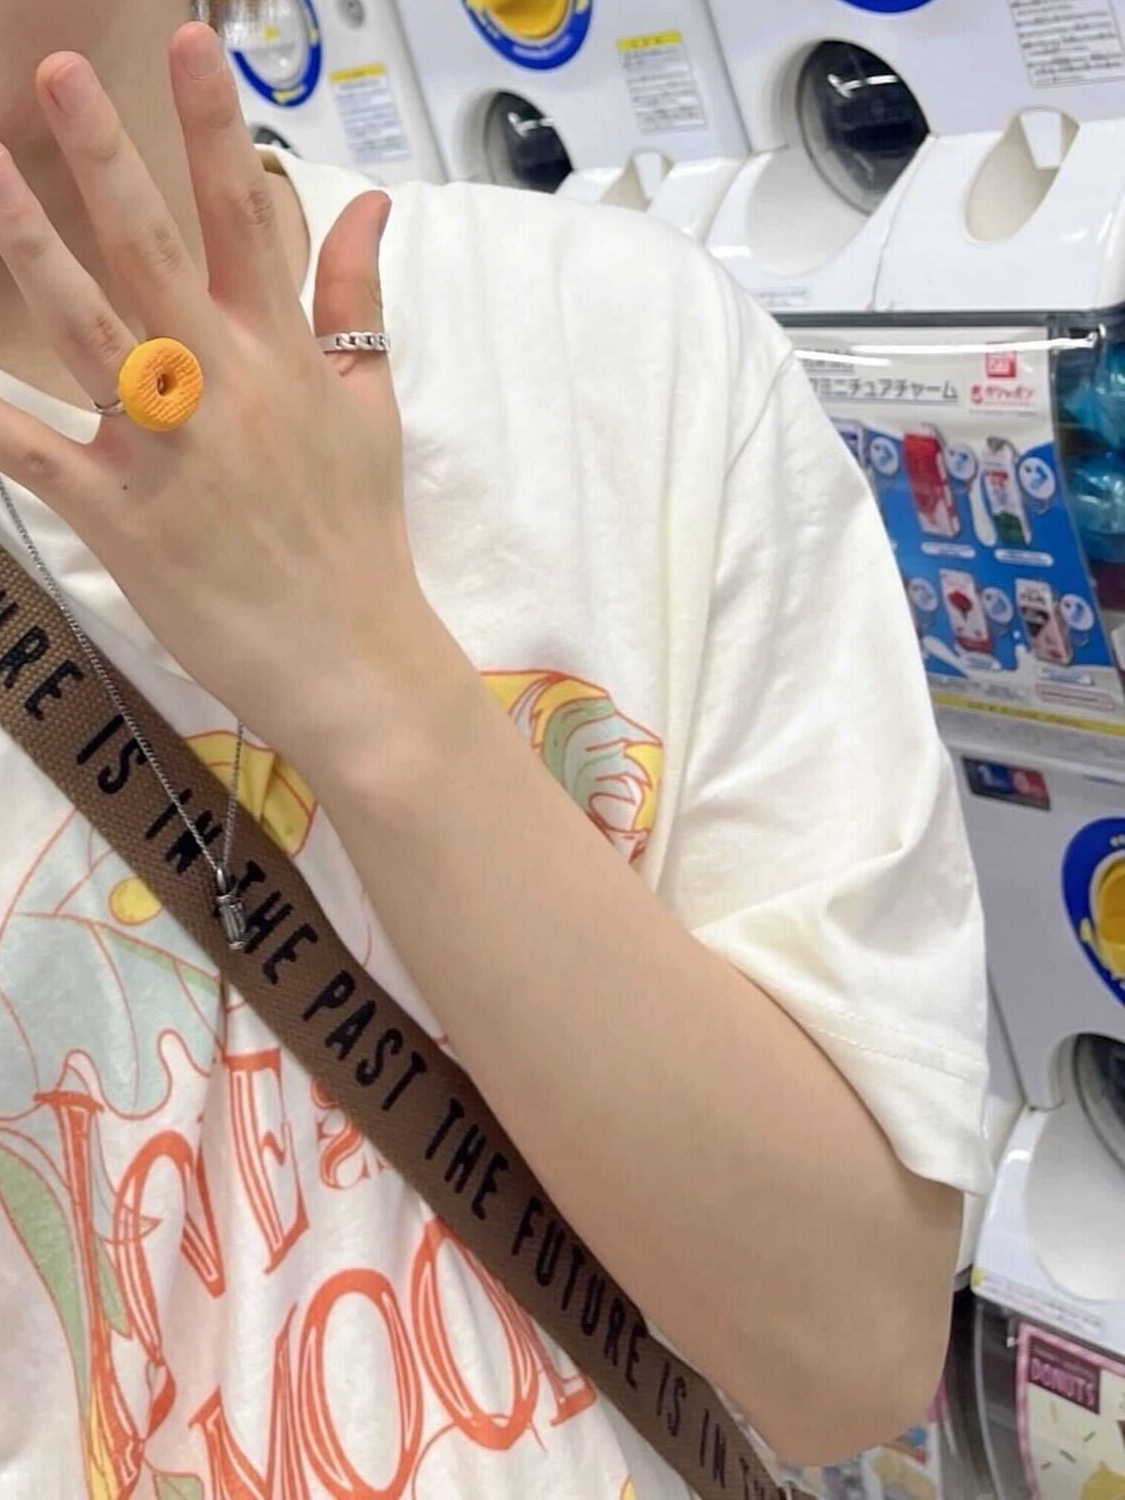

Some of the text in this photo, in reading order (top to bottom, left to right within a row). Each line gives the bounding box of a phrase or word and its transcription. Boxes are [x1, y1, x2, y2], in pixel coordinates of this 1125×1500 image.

[76, 713, 149, 795] IS
[301, 969, 428, 1112] PAST
[424, 1096, 510, 1221] THE
[511, 1196, 650, 1391] FUTURE
[656, 1361, 688, 1437] IS
[699, 1408, 727, 1490] IN
